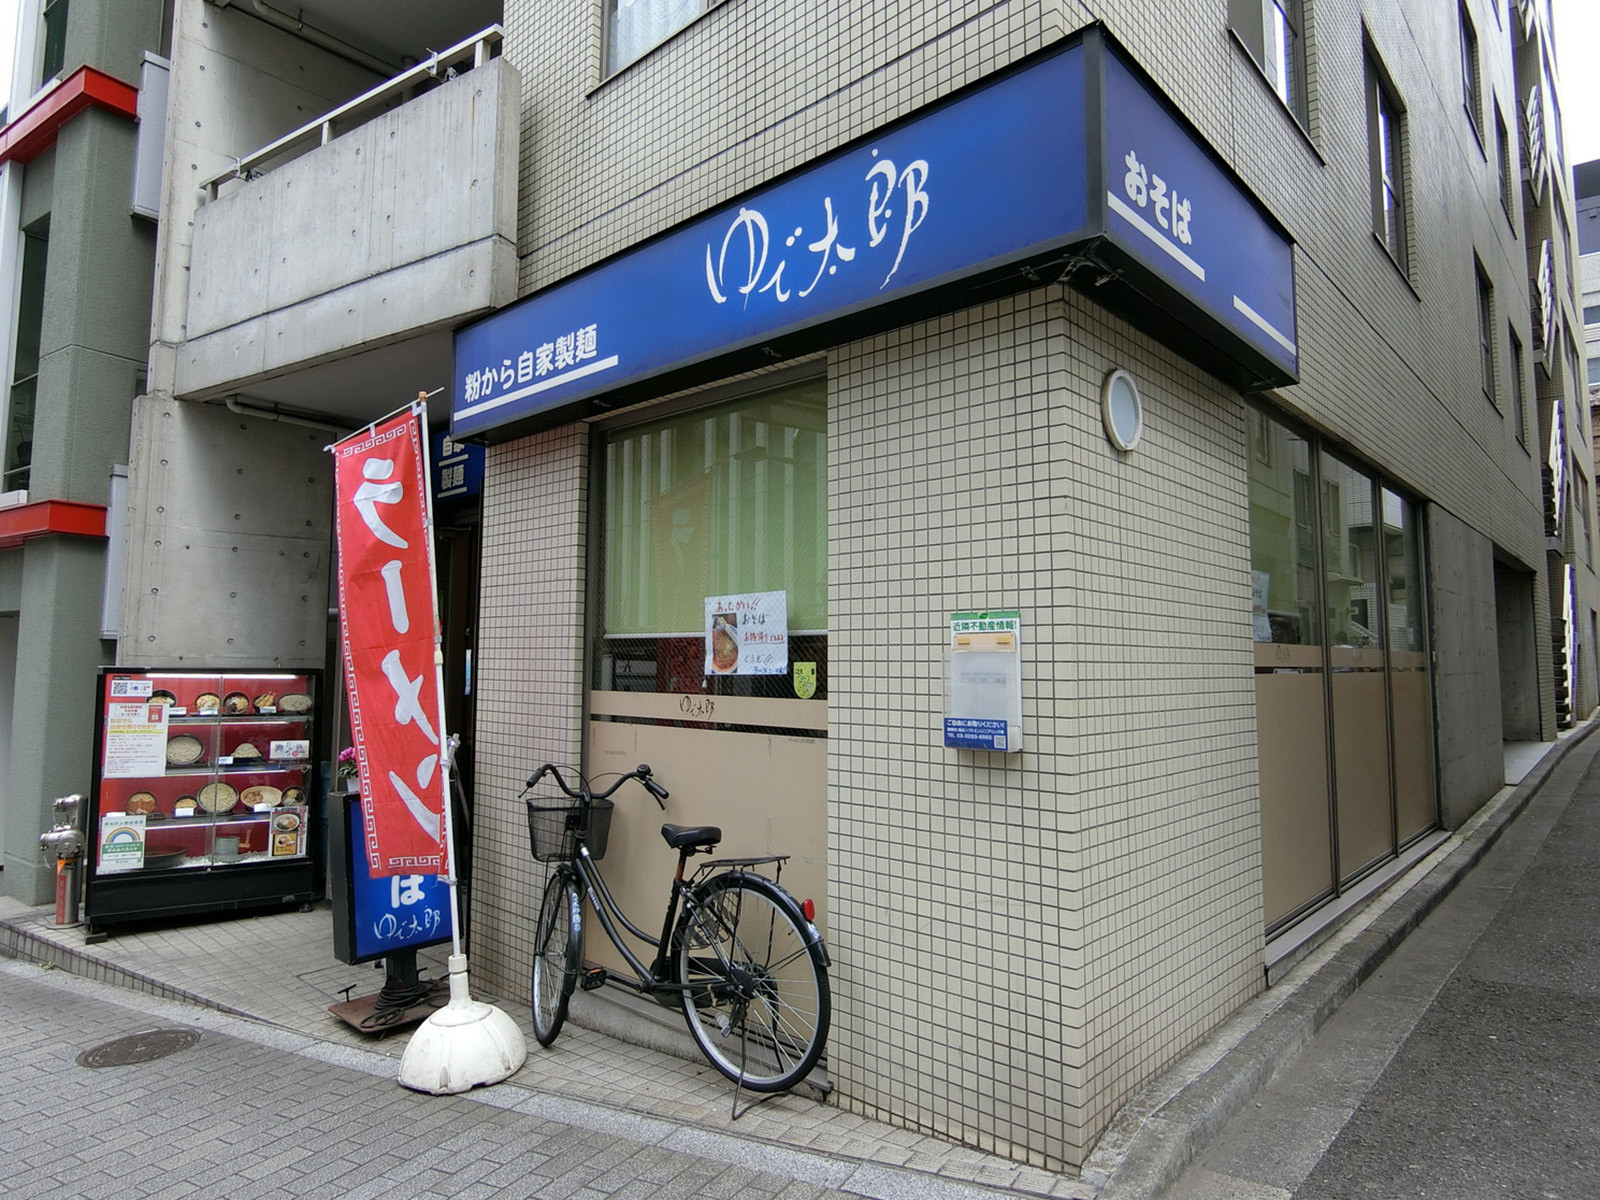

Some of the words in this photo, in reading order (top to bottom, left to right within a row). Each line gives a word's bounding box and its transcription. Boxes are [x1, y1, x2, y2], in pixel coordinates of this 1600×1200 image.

[1124, 150, 1193, 245] おそば
[464, 323, 597, 403] 粉から自家製麺
[441, 464, 465, 491] 製麺
[353, 457, 441, 844] ラーメン
[742, 613, 769, 626] おそば
